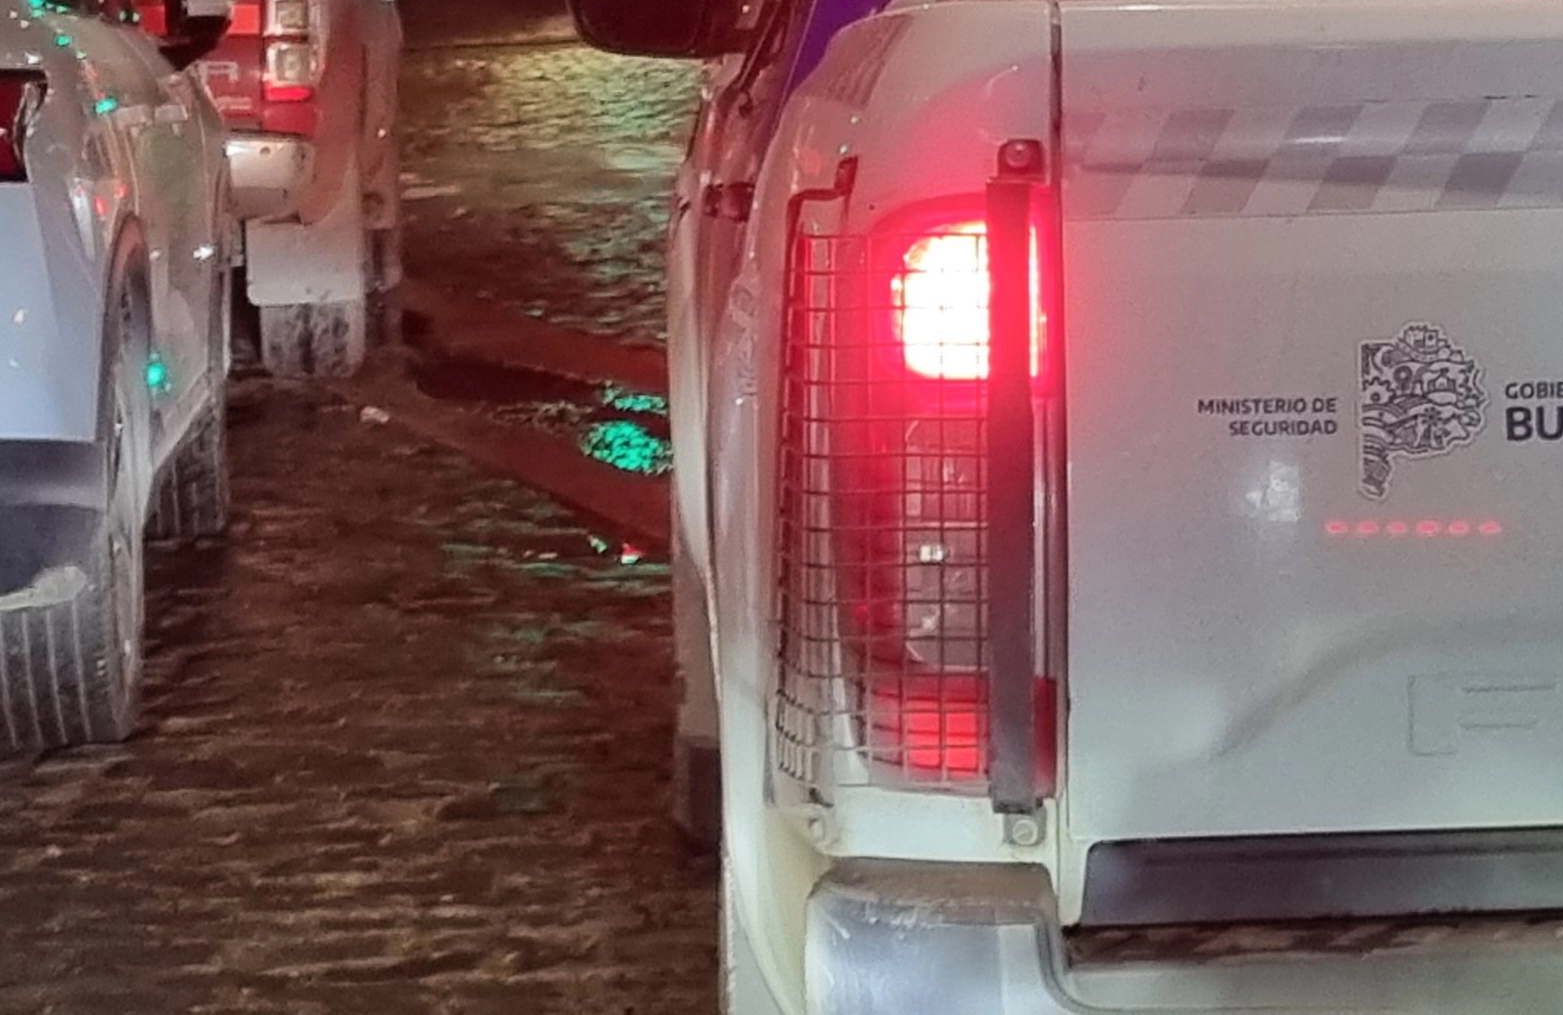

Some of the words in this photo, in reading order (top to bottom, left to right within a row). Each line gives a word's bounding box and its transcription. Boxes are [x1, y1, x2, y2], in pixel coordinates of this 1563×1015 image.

[1197, 396, 1307, 414] MINISTERIO
[1311, 396, 1338, 413] DE
[1228, 418, 1338, 436] SEGURIDAD
